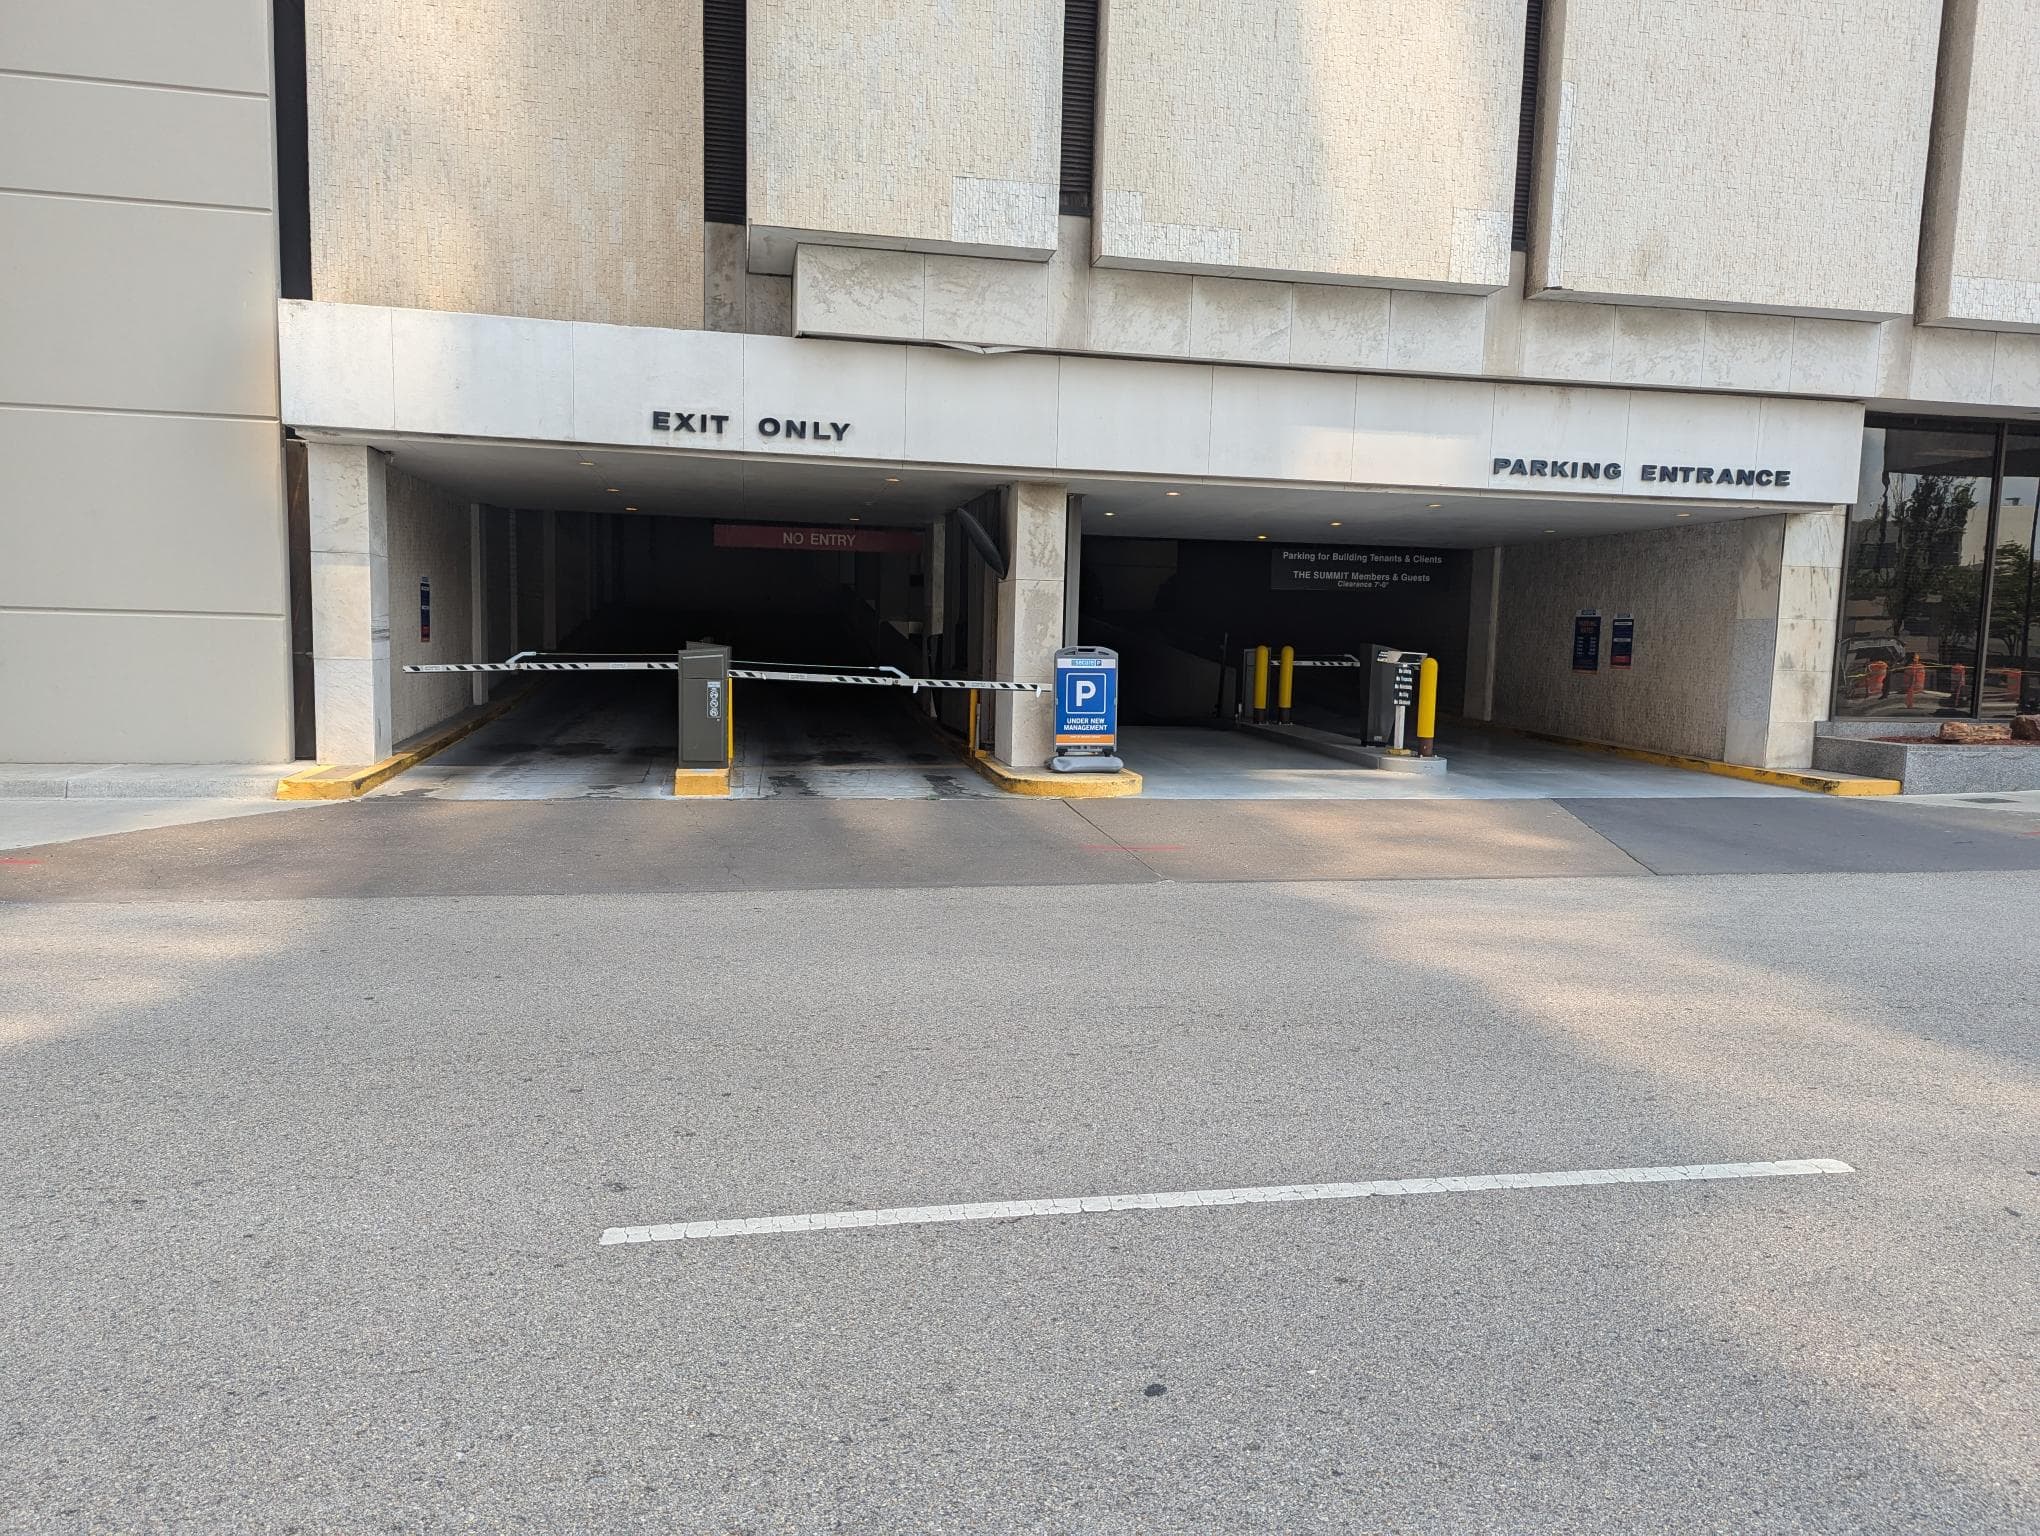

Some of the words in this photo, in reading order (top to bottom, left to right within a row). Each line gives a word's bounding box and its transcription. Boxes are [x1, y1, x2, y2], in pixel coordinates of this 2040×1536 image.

[652, 411, 729, 434] EXIT
[758, 417, 851, 441] ONLY
[1493, 458, 1622, 480] PARKING
[1641, 464, 1791, 487] ENTRANCE
[783, 532, 804, 545] NO
[810, 533, 856, 547] ENTRY
[1282, 551, 1316, 562] Parking
[1317, 552, 1330, 561] for
[1332, 552, 1367, 563] Building
[1370, 553, 1402, 563] Tenants
[1404, 555, 1411, 563] &
[1413, 555, 1442, 564] Clients
[1293, 570, 1311, 579] THE
[1313, 571, 1349, 580] SUMMIT
[1351, 572, 1390, 581] Members
[1392, 573, 1399, 581] &
[1401, 573, 1431, 582] Guests
[1337, 580, 1372, 588] Clearance
[1076, 680, 1096, 706] P
